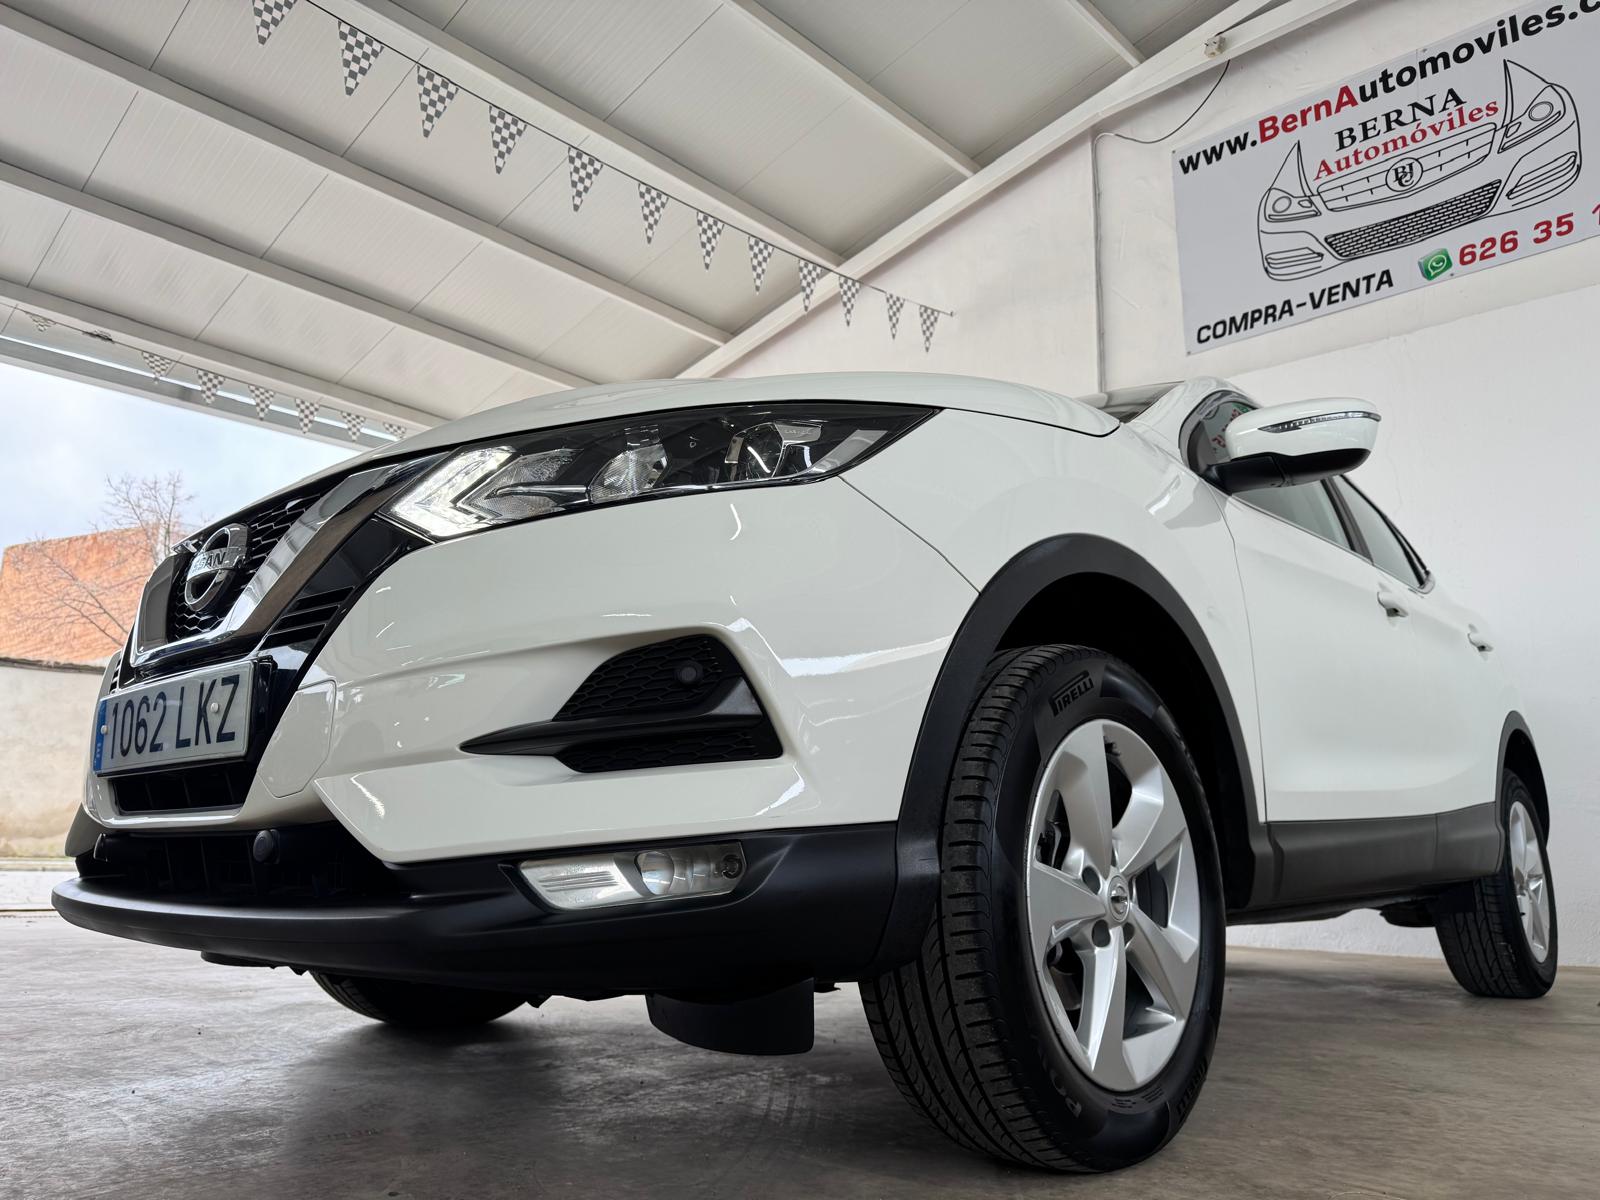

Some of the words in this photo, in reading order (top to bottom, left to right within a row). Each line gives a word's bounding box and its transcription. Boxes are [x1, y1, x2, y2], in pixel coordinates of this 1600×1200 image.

[1313, 100, 1499, 181] Automóviles
[1335, 87, 1467, 151] BERNA
[1458, 230, 1519, 266] 626
[1534, 213, 1574, 245] 35
[1196, 268, 1394, 344] COMPRA-VENTA
[111, 691, 168, 760] 1062
[175, 674, 240, 750] LKZ
[1049, 671, 1094, 717] PIRELLI
